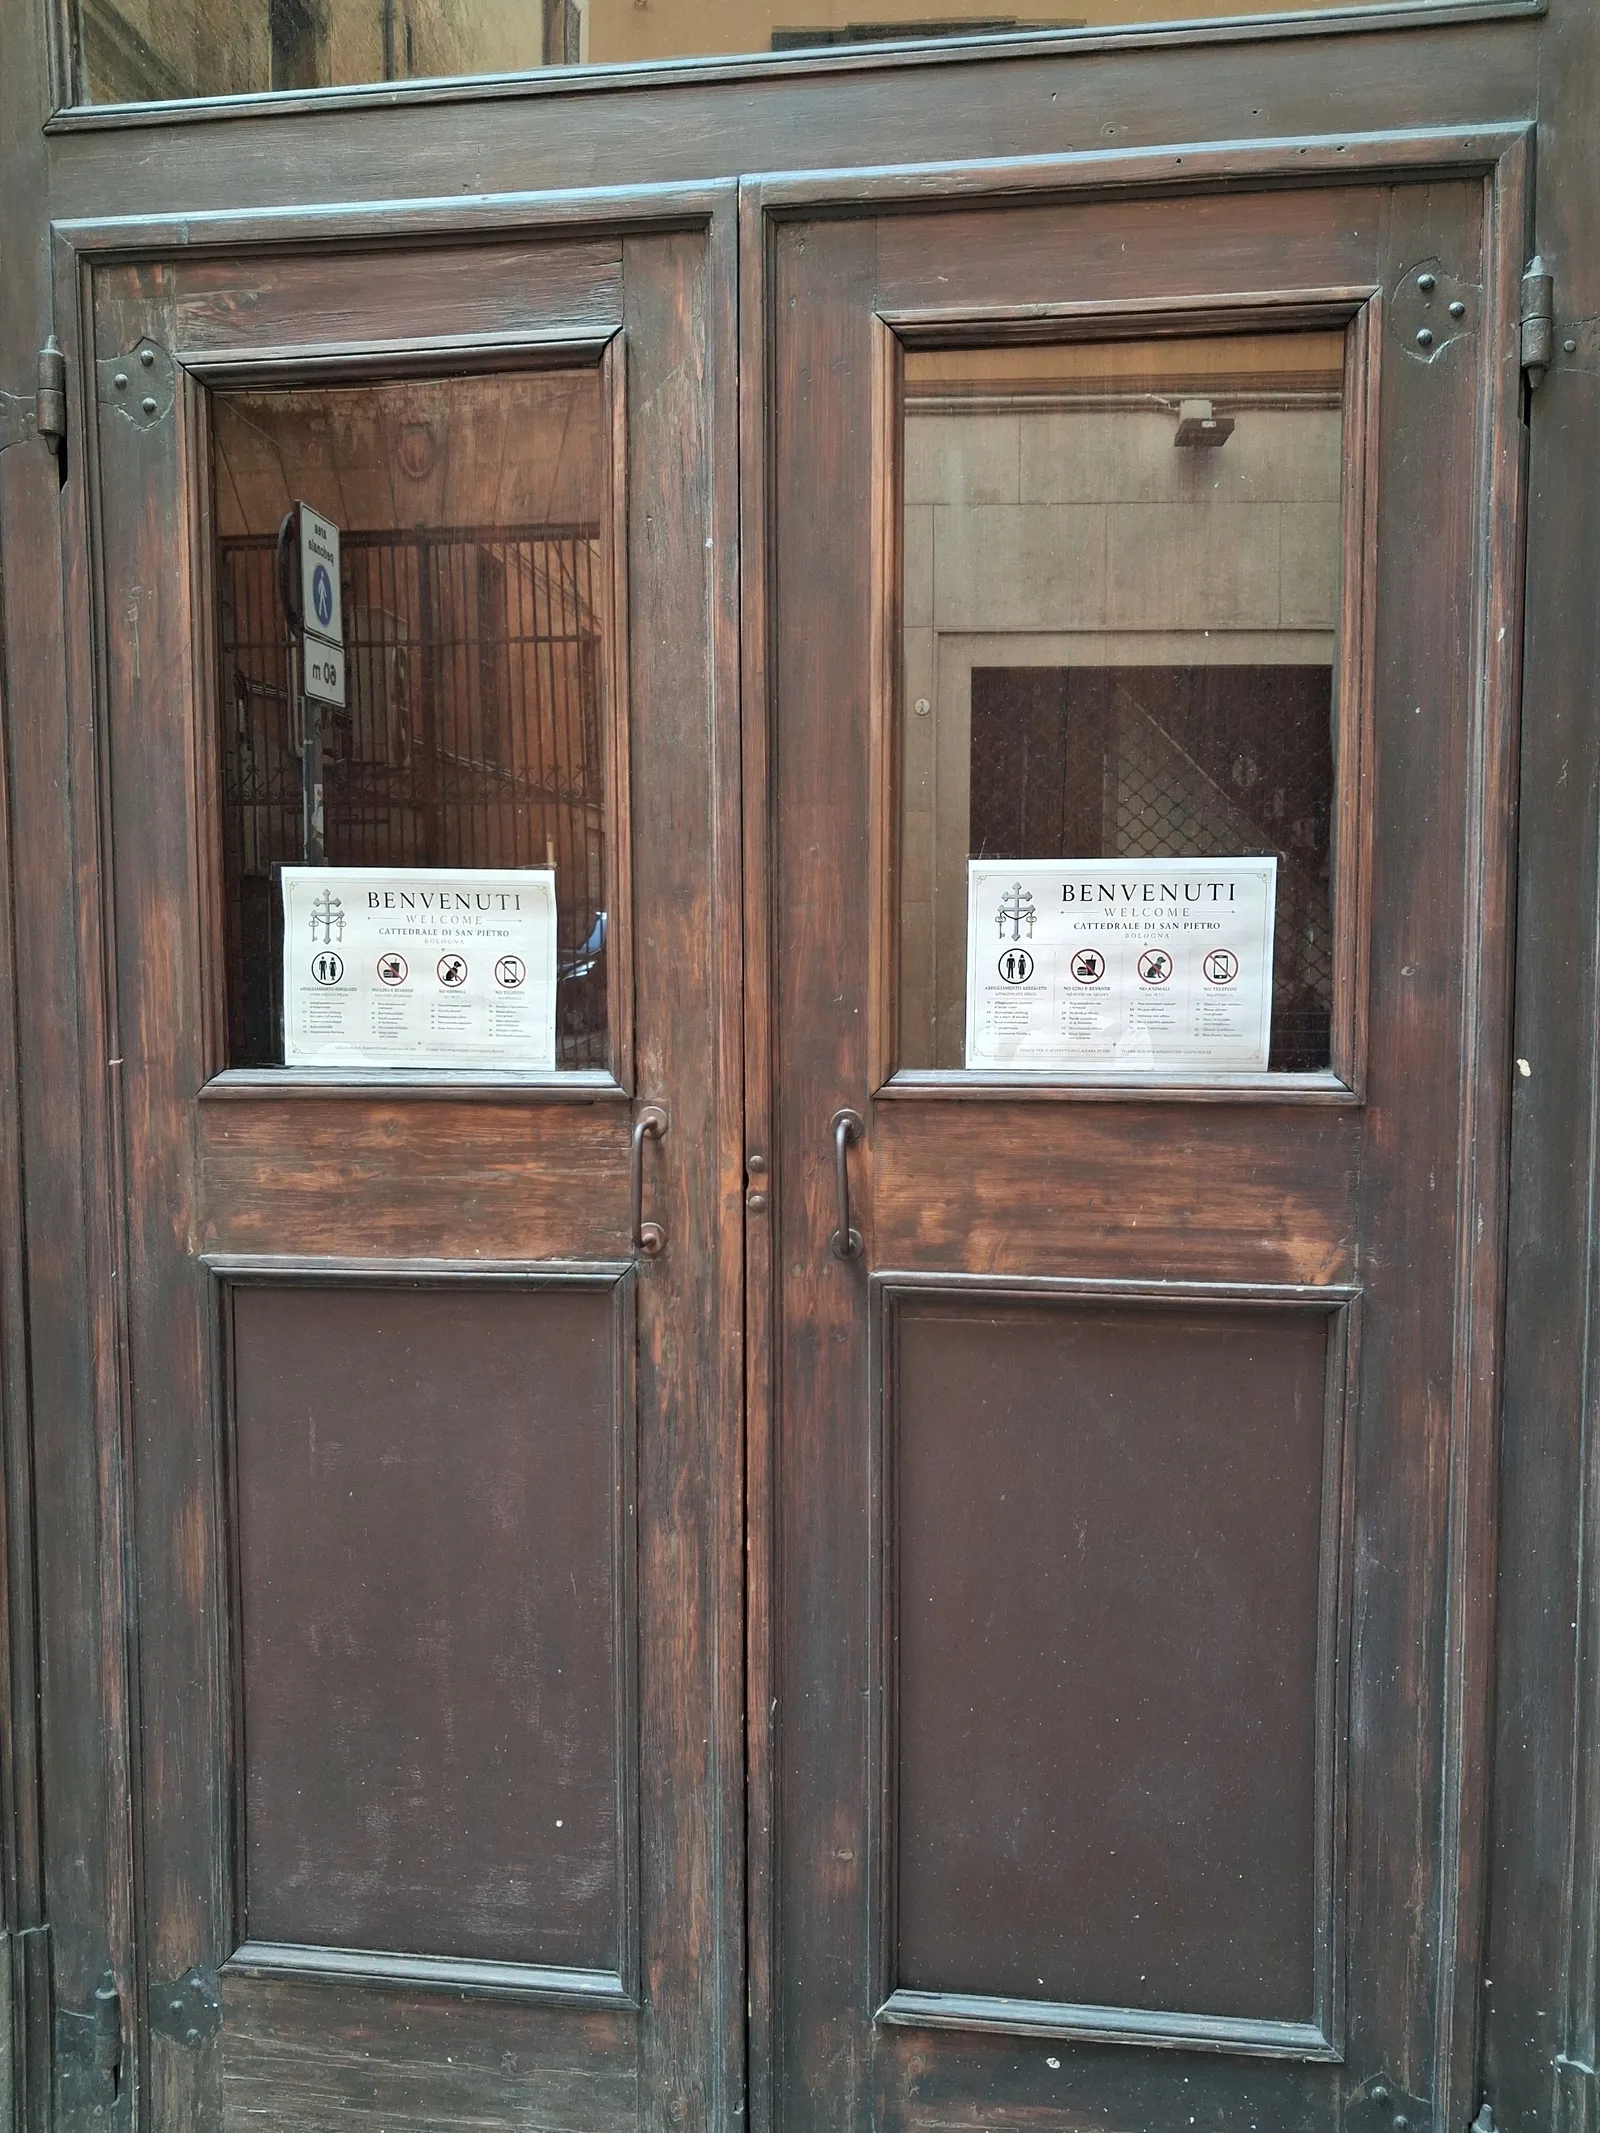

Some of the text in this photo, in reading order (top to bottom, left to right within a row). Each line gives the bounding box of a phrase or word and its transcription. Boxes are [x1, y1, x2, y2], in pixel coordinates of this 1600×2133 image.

[1062, 883, 1236, 902] BENVENUTI
[368, 891, 522, 911] BENVENUTI
[1104, 907, 1190, 918] WELCOME
[405, 914, 483, 925] WELCOME
[1073, 921, 1221, 930] CATTEDRALE DI SAN PIETRO
[378, 927, 438, 936] CATTEDRALE
[441, 928, 452, 936] DI
[477, 929, 510, 937] PIETRO
